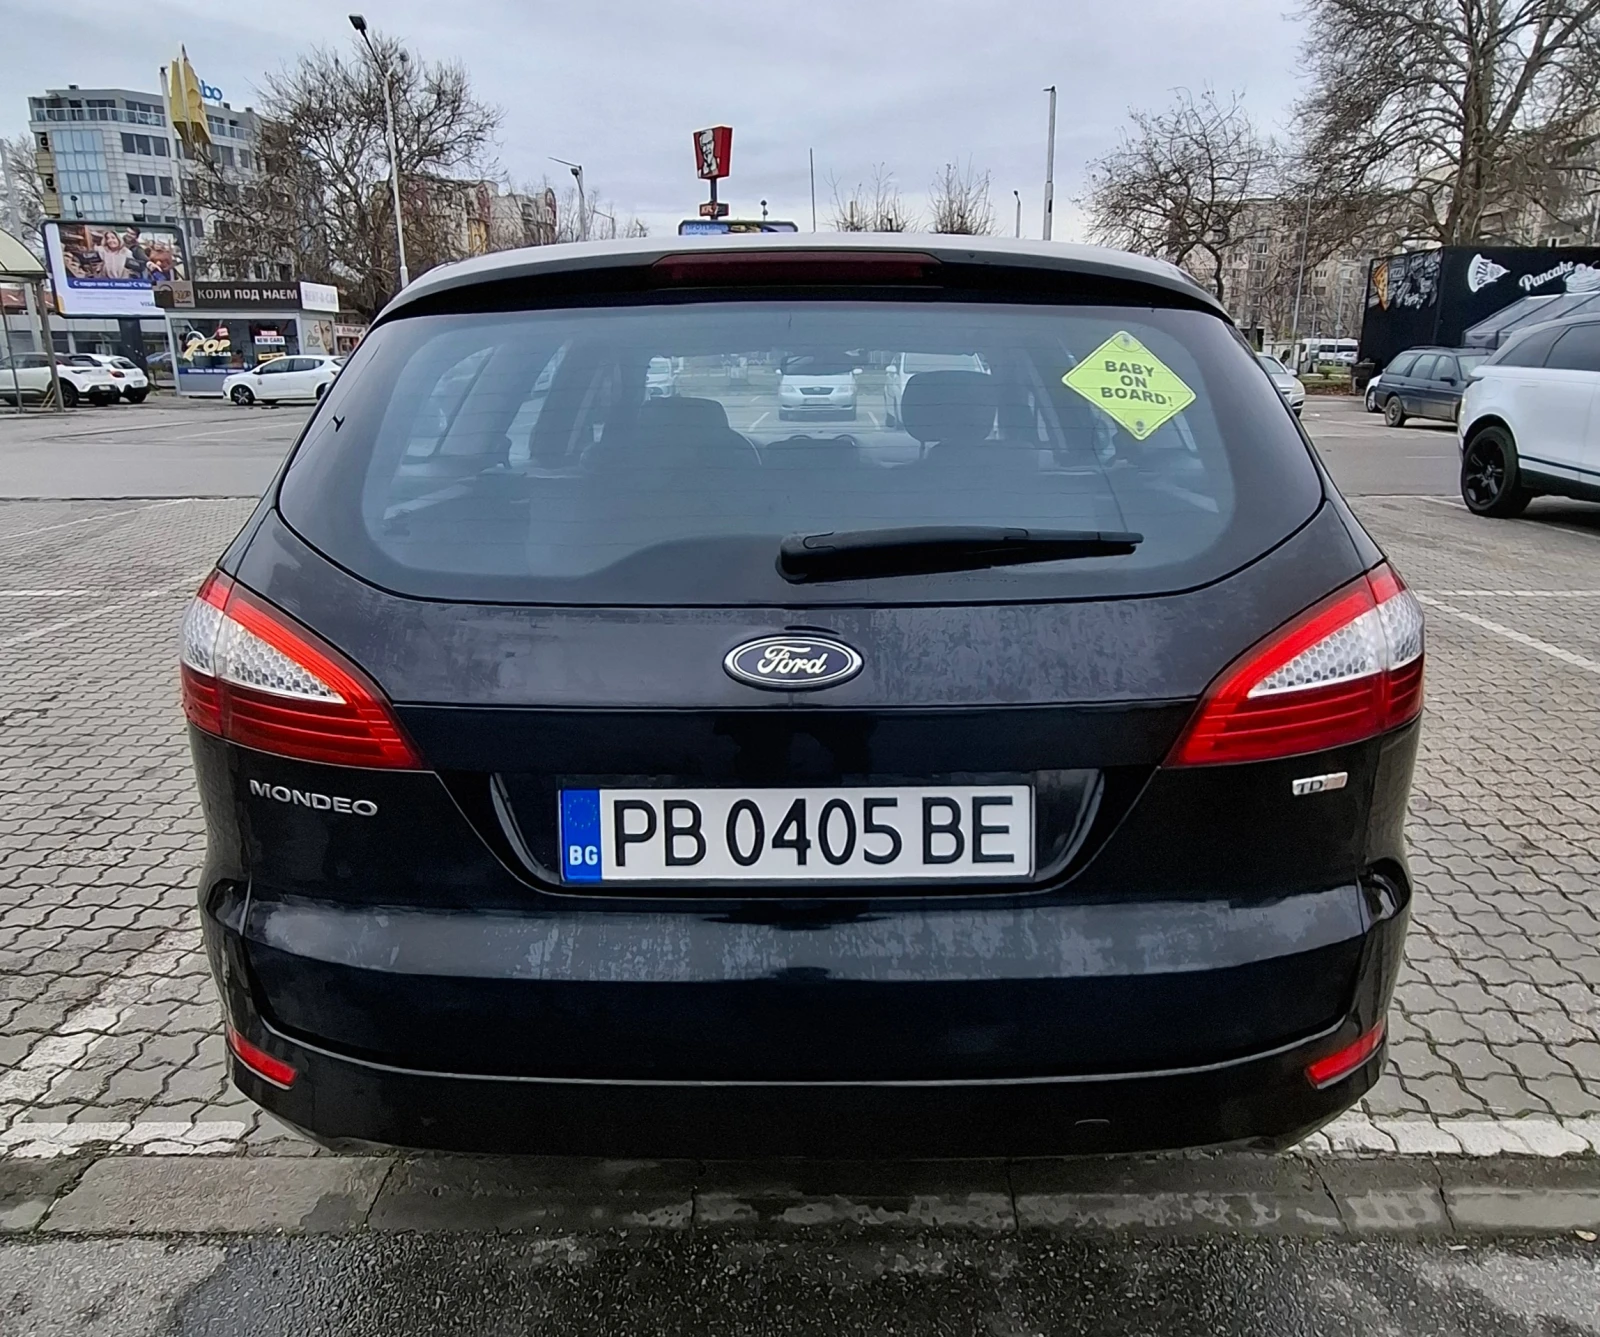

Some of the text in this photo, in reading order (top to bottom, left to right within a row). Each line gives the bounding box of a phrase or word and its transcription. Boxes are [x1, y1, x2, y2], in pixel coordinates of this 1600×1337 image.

[200, 79, 223, 101] bo
[1475, 261, 1490, 286] PIZZA
[1518, 261, 1575, 291] Pancake
[197, 289, 231, 299] КОЛИ
[234, 289, 260, 300] ПОД
[262, 289, 298, 299] НАЕМ
[183, 338, 231, 361] TOP
[1105, 360, 1154, 378] BABY
[1120, 375, 1148, 388] ON
[1101, 387, 1173, 407] BOARD!
[757, 645, 829, 674] Ford
[249, 779, 378, 816] MONDEO
[613, 796, 1015, 867] PB 0405 BE
[569, 845, 598, 866] BG
